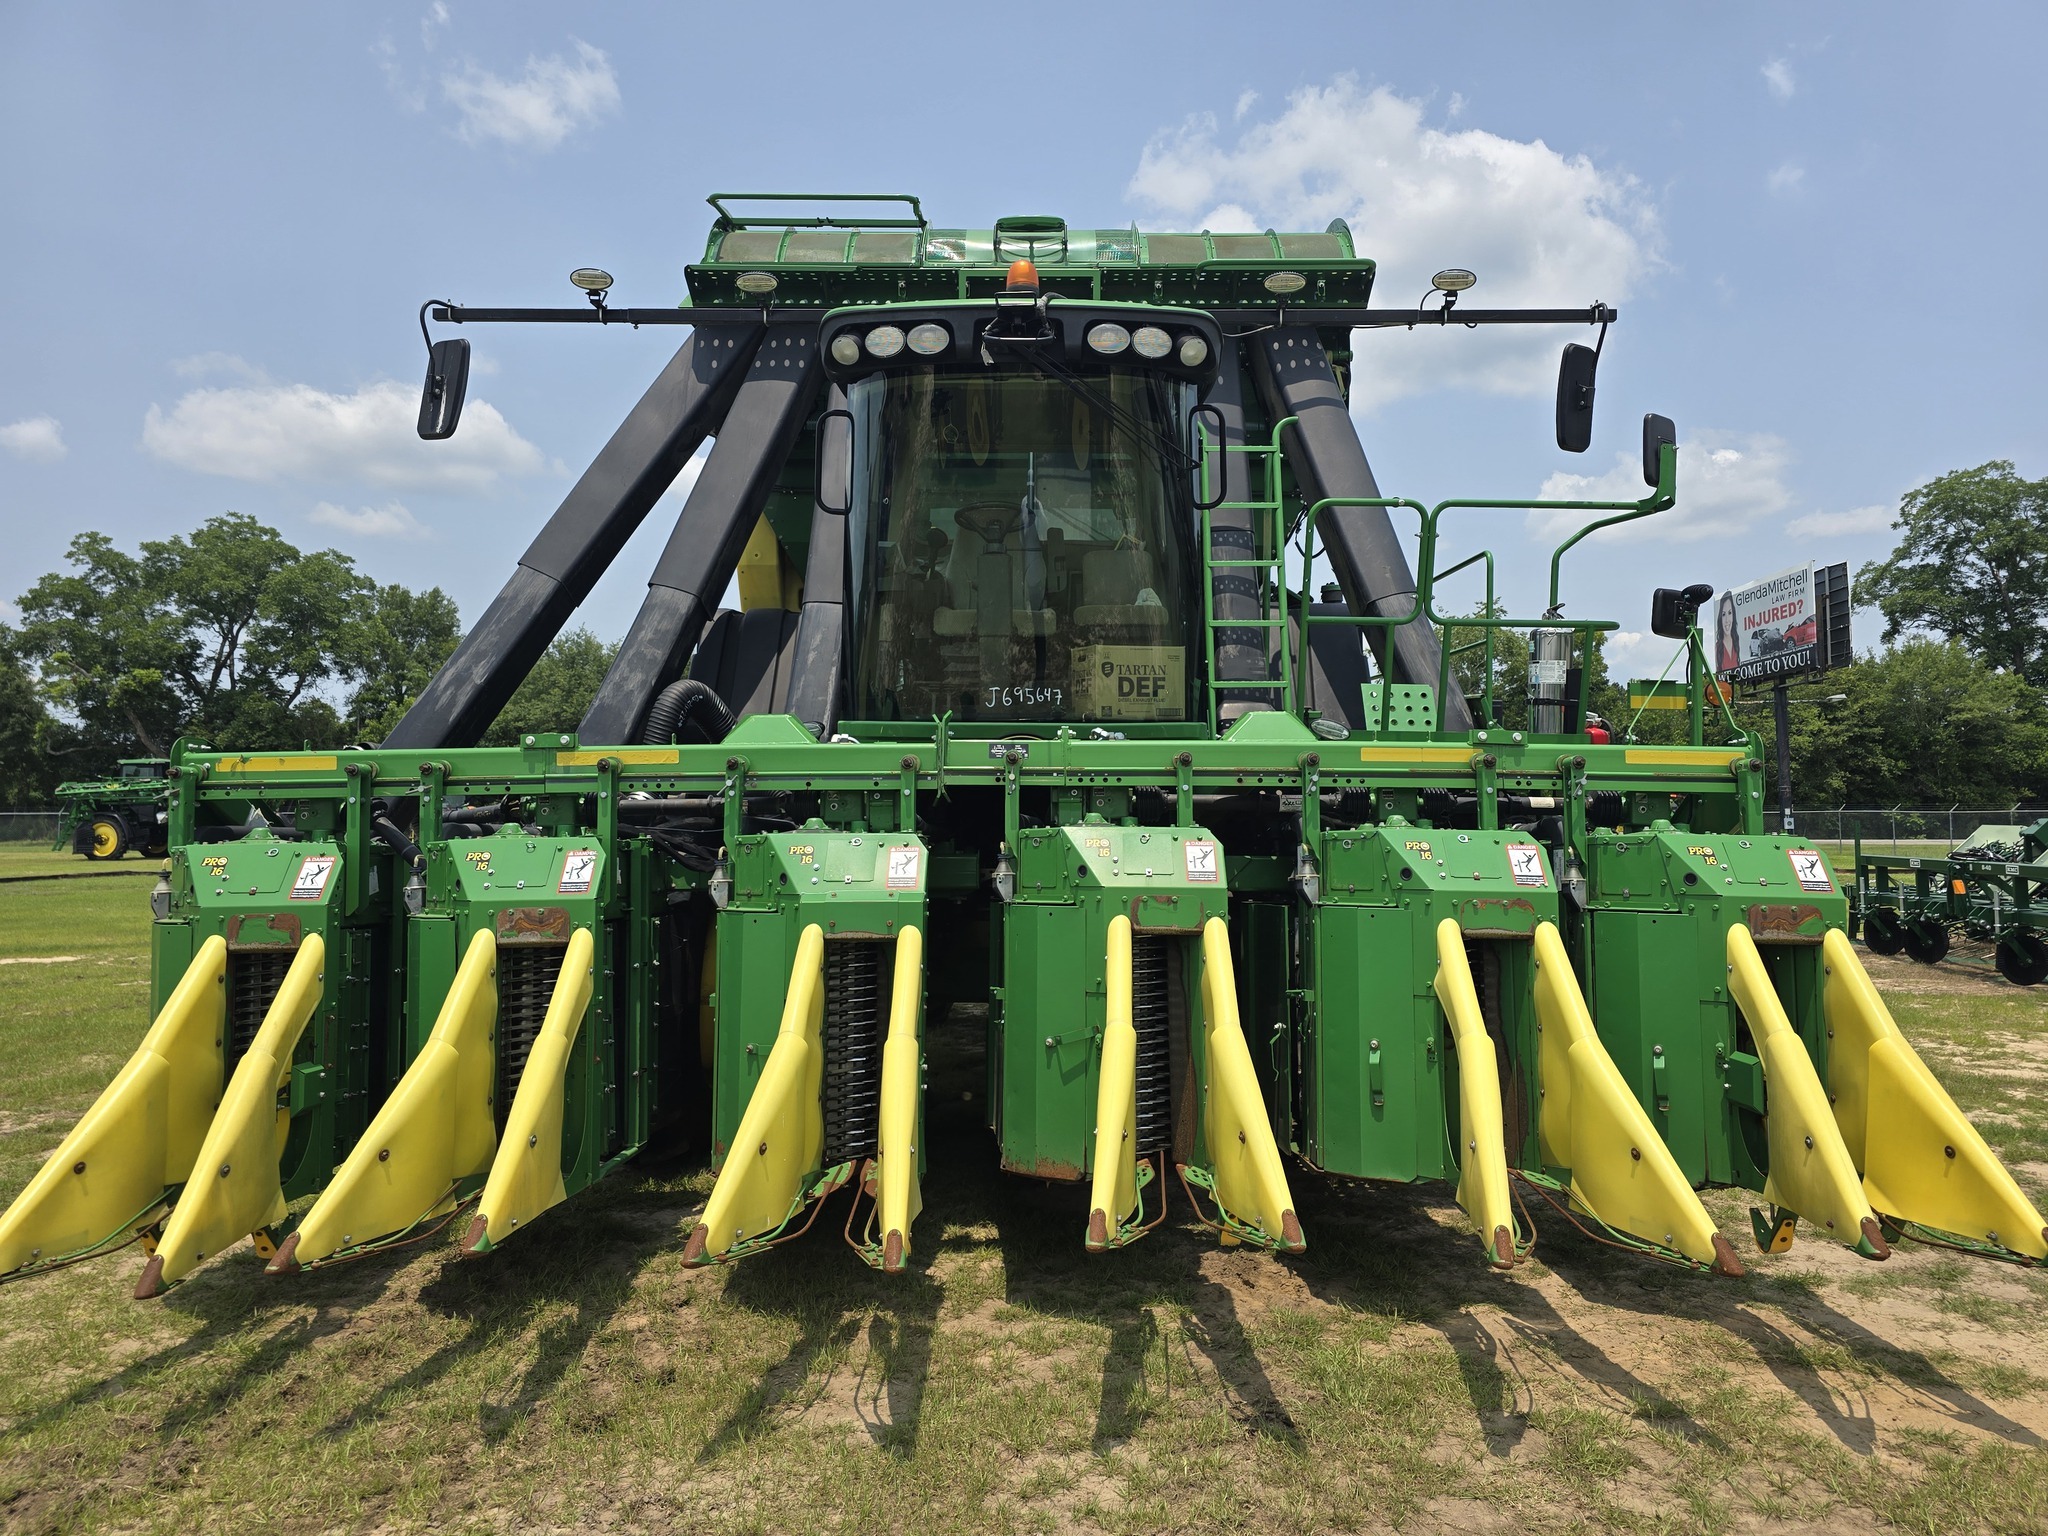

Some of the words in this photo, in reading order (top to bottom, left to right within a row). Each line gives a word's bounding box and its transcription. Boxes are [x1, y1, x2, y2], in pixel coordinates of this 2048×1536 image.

[1735, 568, 1808, 606] GlendaMitchell
[1771, 594, 1787, 604] LAW
[1788, 587, 1805, 598] FIRM
[1743, 599, 1804, 631] INJURED?
[1116, 664, 1167, 676] TARTAN
[1734, 662, 1764, 681] COME
[1764, 659, 1780, 675] TO
[1781, 650, 1811, 671] YOU!
[1118, 676, 1166, 698] DEF
[986, 686, 1062, 708] J695647
[1085, 839, 1110, 848] PRO
[1405, 842, 1430, 850] PRO
[789, 846, 814, 855] PRO
[1098, 848, 1111, 857] 16
[1688, 847, 1714, 856] PRO
[465, 852, 492, 861] PRO
[801, 855, 814, 864] 16
[1420, 851, 1433, 860] 16
[201, 857, 228, 867] PRO
[1704, 856, 1718, 866] 16
[476, 862, 488, 871] 16
[210, 867, 224, 876] 16
